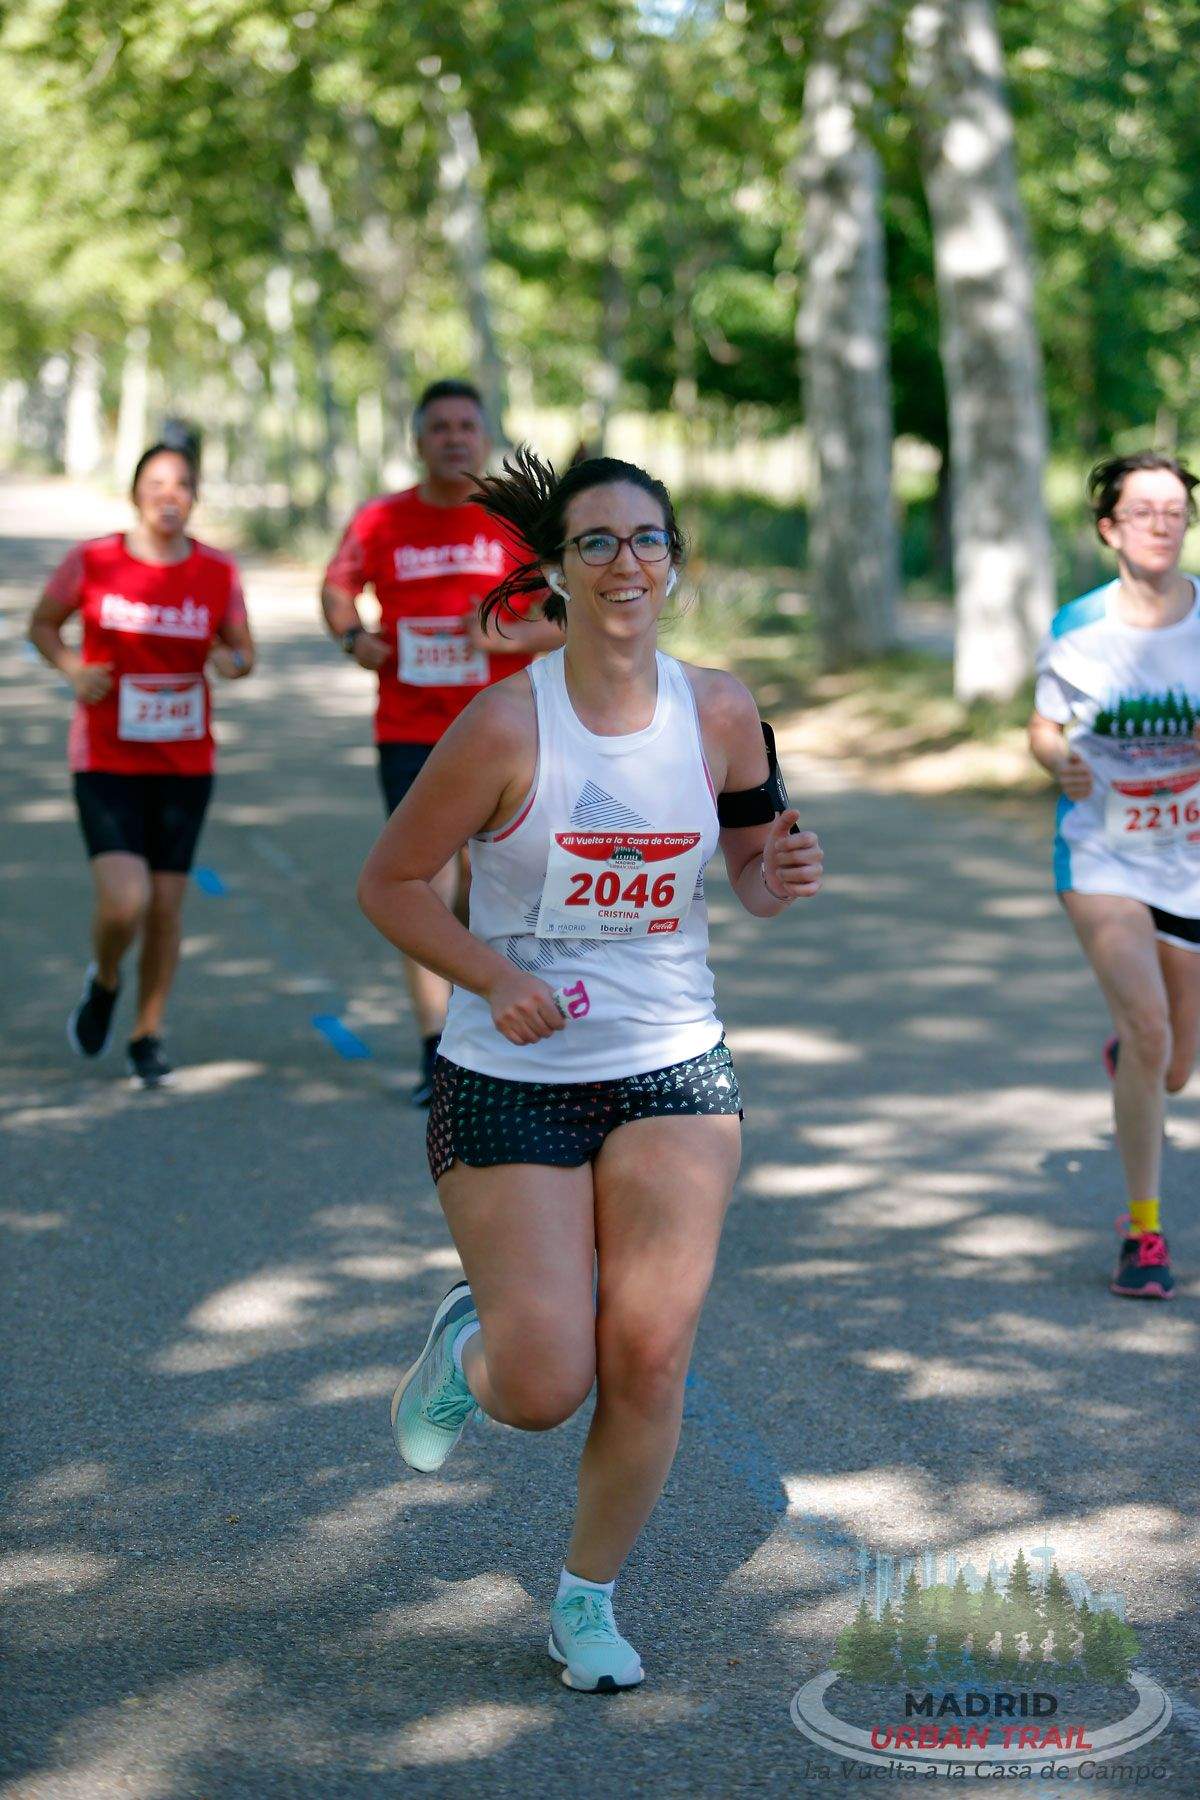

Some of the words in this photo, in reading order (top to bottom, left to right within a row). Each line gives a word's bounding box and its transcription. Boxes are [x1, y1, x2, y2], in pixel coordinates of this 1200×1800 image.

[562, 837, 574, 845] XII
[577, 836, 604, 845] Vuelta
[614, 836, 623, 844] la
[651, 837, 661, 845] de
[664, 837, 695, 846] Campo
[565, 871, 676, 908] 2046
[598, 910, 640, 919] CRISTINA
[600, 924, 633, 933] Iberext
